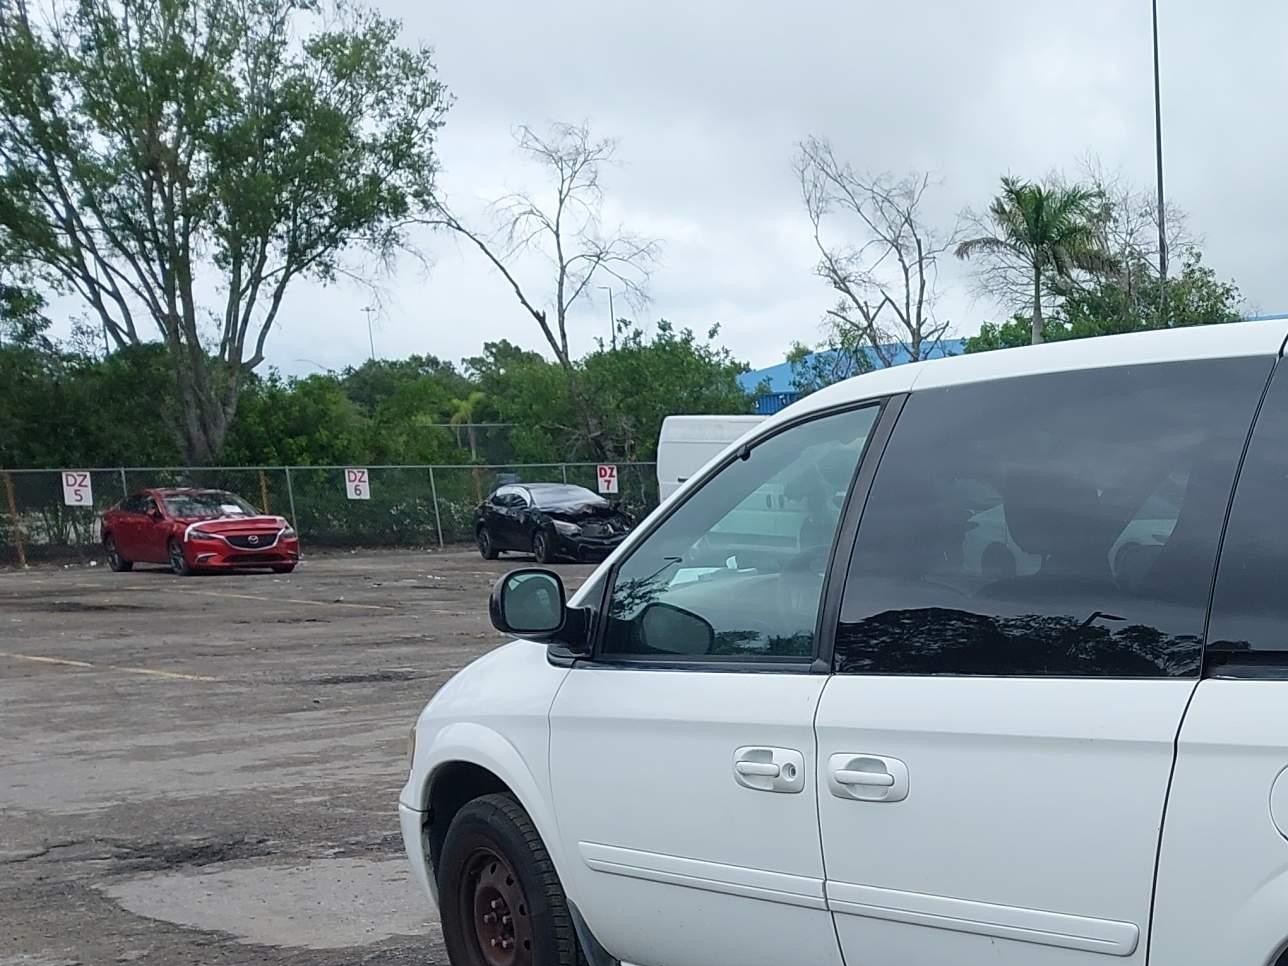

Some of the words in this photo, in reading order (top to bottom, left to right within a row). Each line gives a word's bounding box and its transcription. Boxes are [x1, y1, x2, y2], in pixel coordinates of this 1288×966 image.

[347, 470, 367, 483] DZ
[599, 466, 615, 478] DZ
[65, 473, 88, 488] DZ
[603, 479, 612, 491] 7
[74, 489, 83, 502] 5
[354, 484, 362, 496] 6
